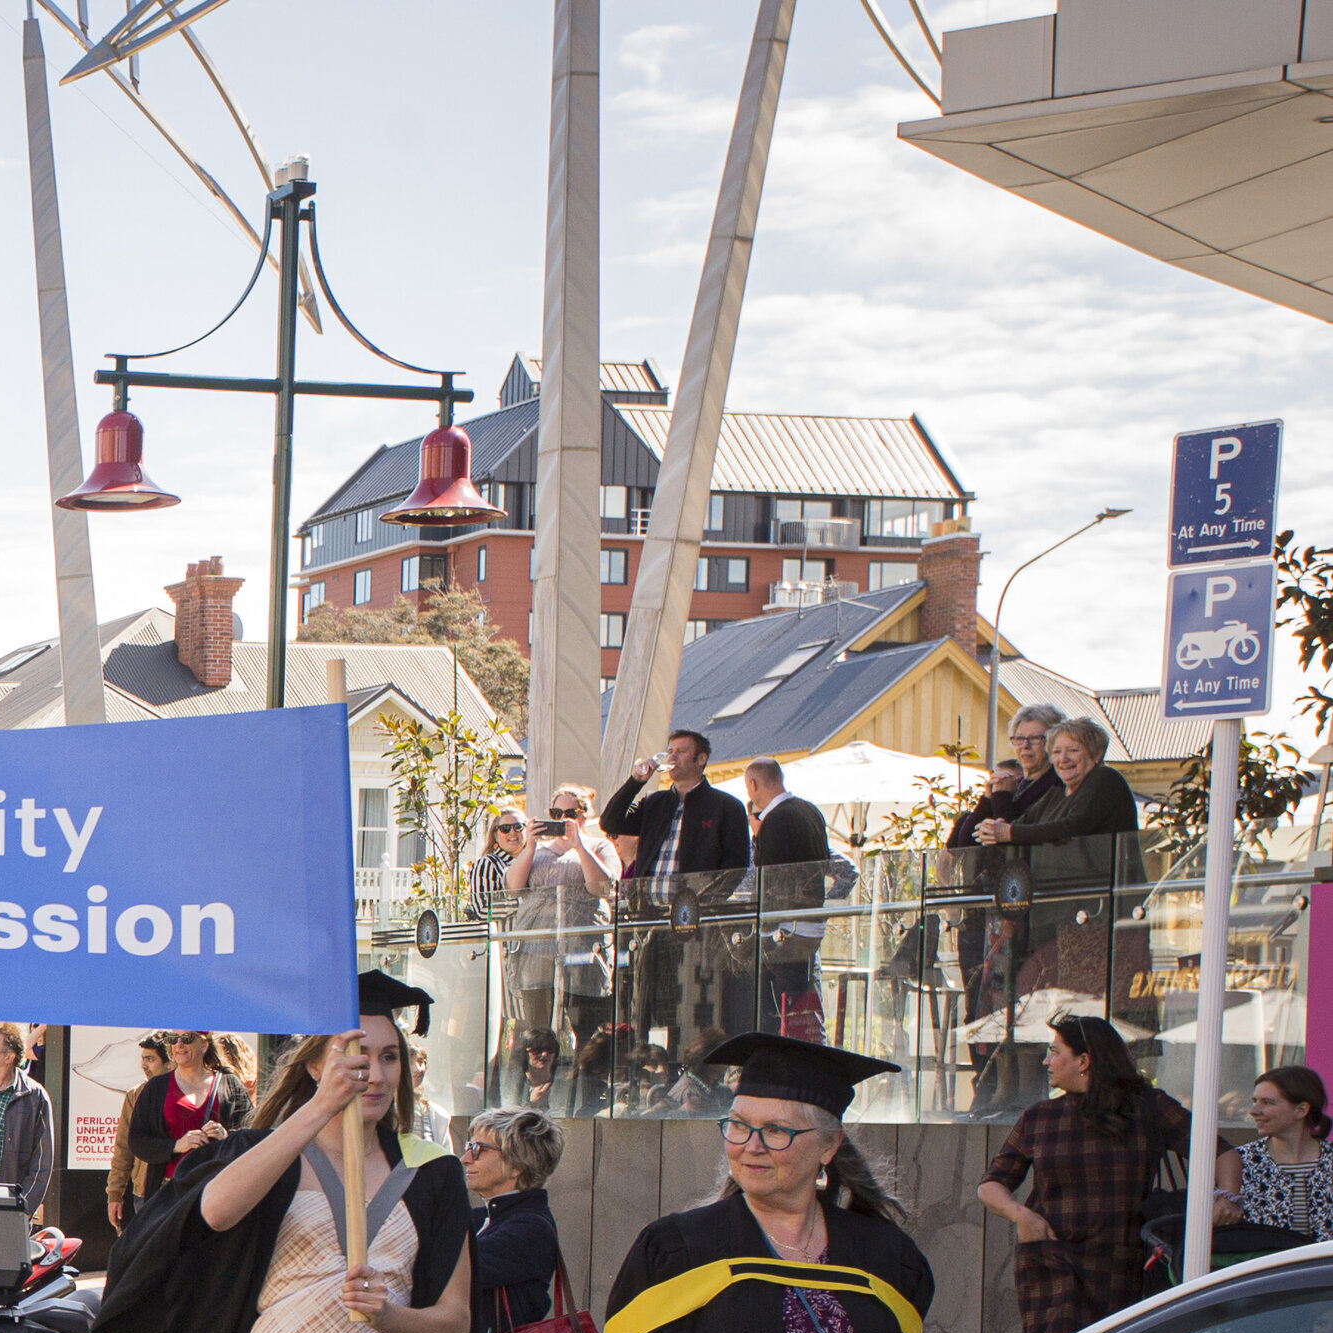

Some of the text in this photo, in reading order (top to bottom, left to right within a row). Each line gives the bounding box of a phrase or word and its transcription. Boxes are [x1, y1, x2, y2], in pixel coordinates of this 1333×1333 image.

[1209, 437, 1242, 480] P
[1214, 483, 1231, 515] 5
[1178, 518, 1265, 539] At Any Time
[1204, 576, 1237, 618] P
[1173, 676, 1260, 695] At Any Time
[76, 1116, 120, 1125] PERILOU
[76, 1136, 105, 1144] FROM
